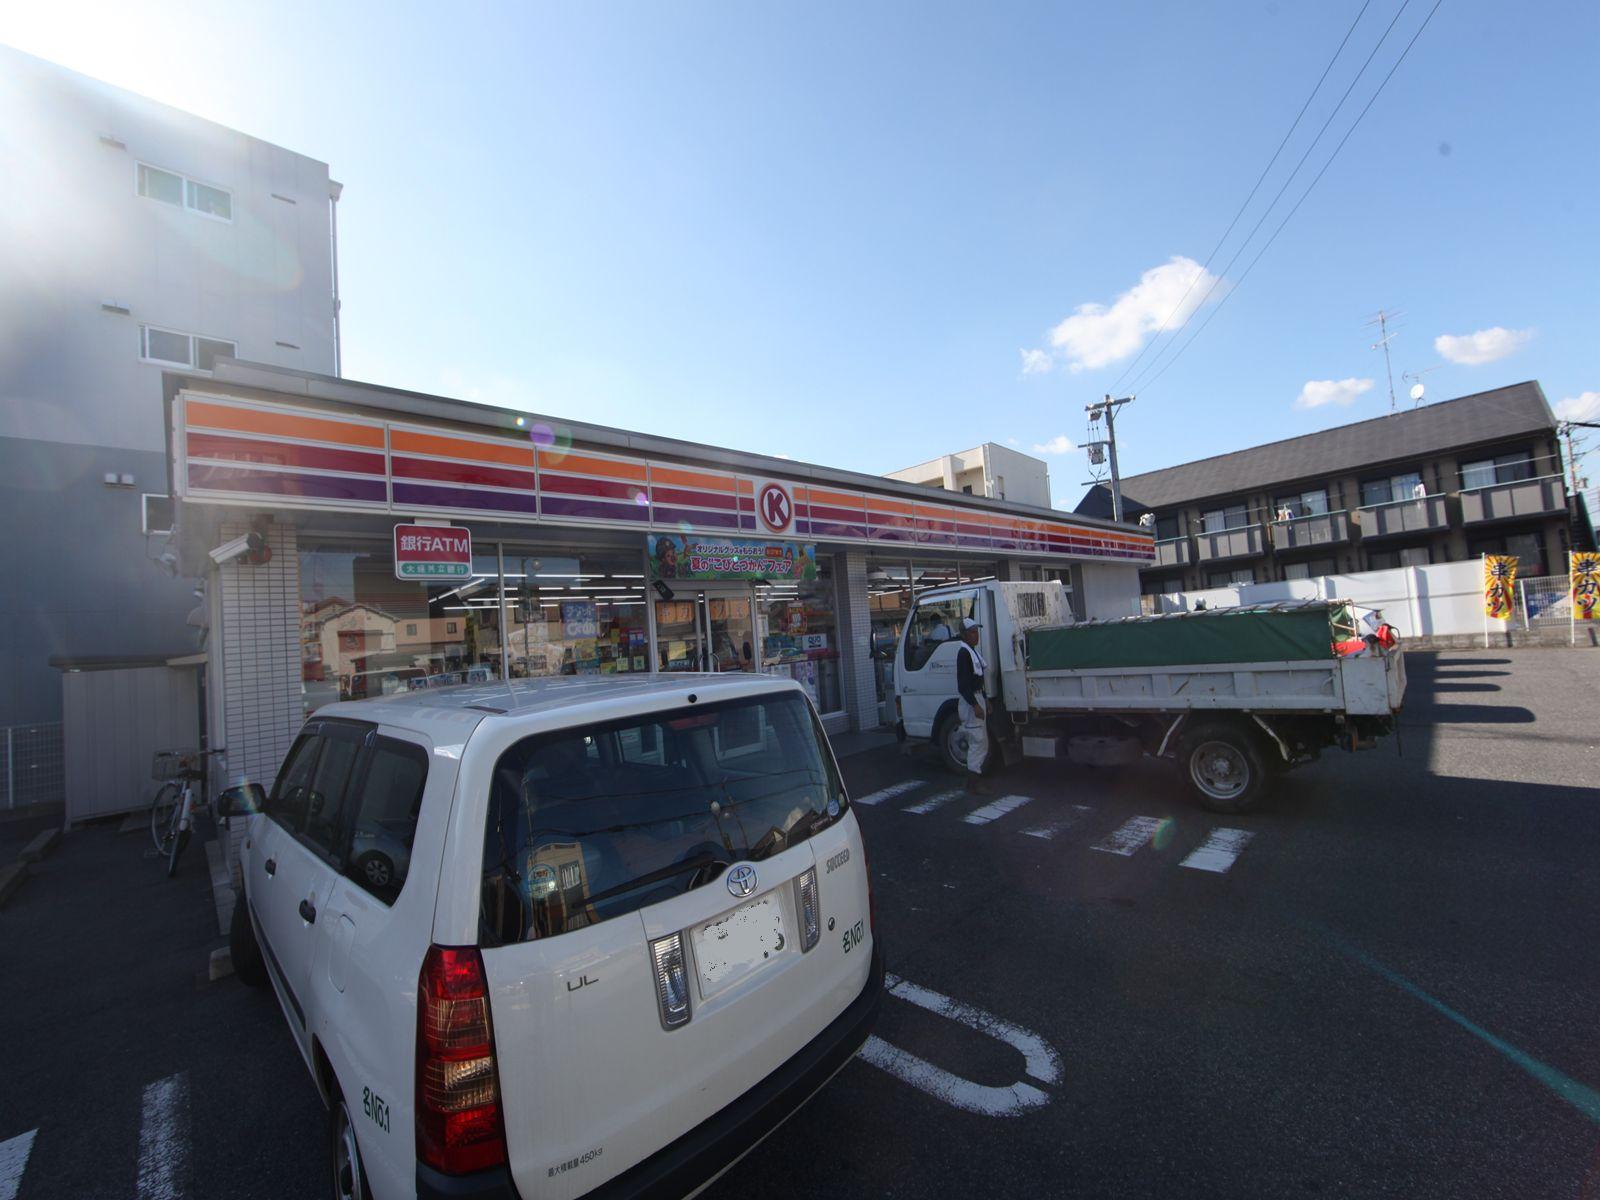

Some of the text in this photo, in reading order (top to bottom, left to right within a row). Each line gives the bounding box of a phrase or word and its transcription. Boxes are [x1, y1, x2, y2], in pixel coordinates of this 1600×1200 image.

[765, 488, 789, 529] K
[400, 535, 469, 553] 銀行ATM
[1487, 562, 1509, 612] 串カツ
[1577, 558, 1600, 611] 串カツ
[567, 975, 599, 991] UL
